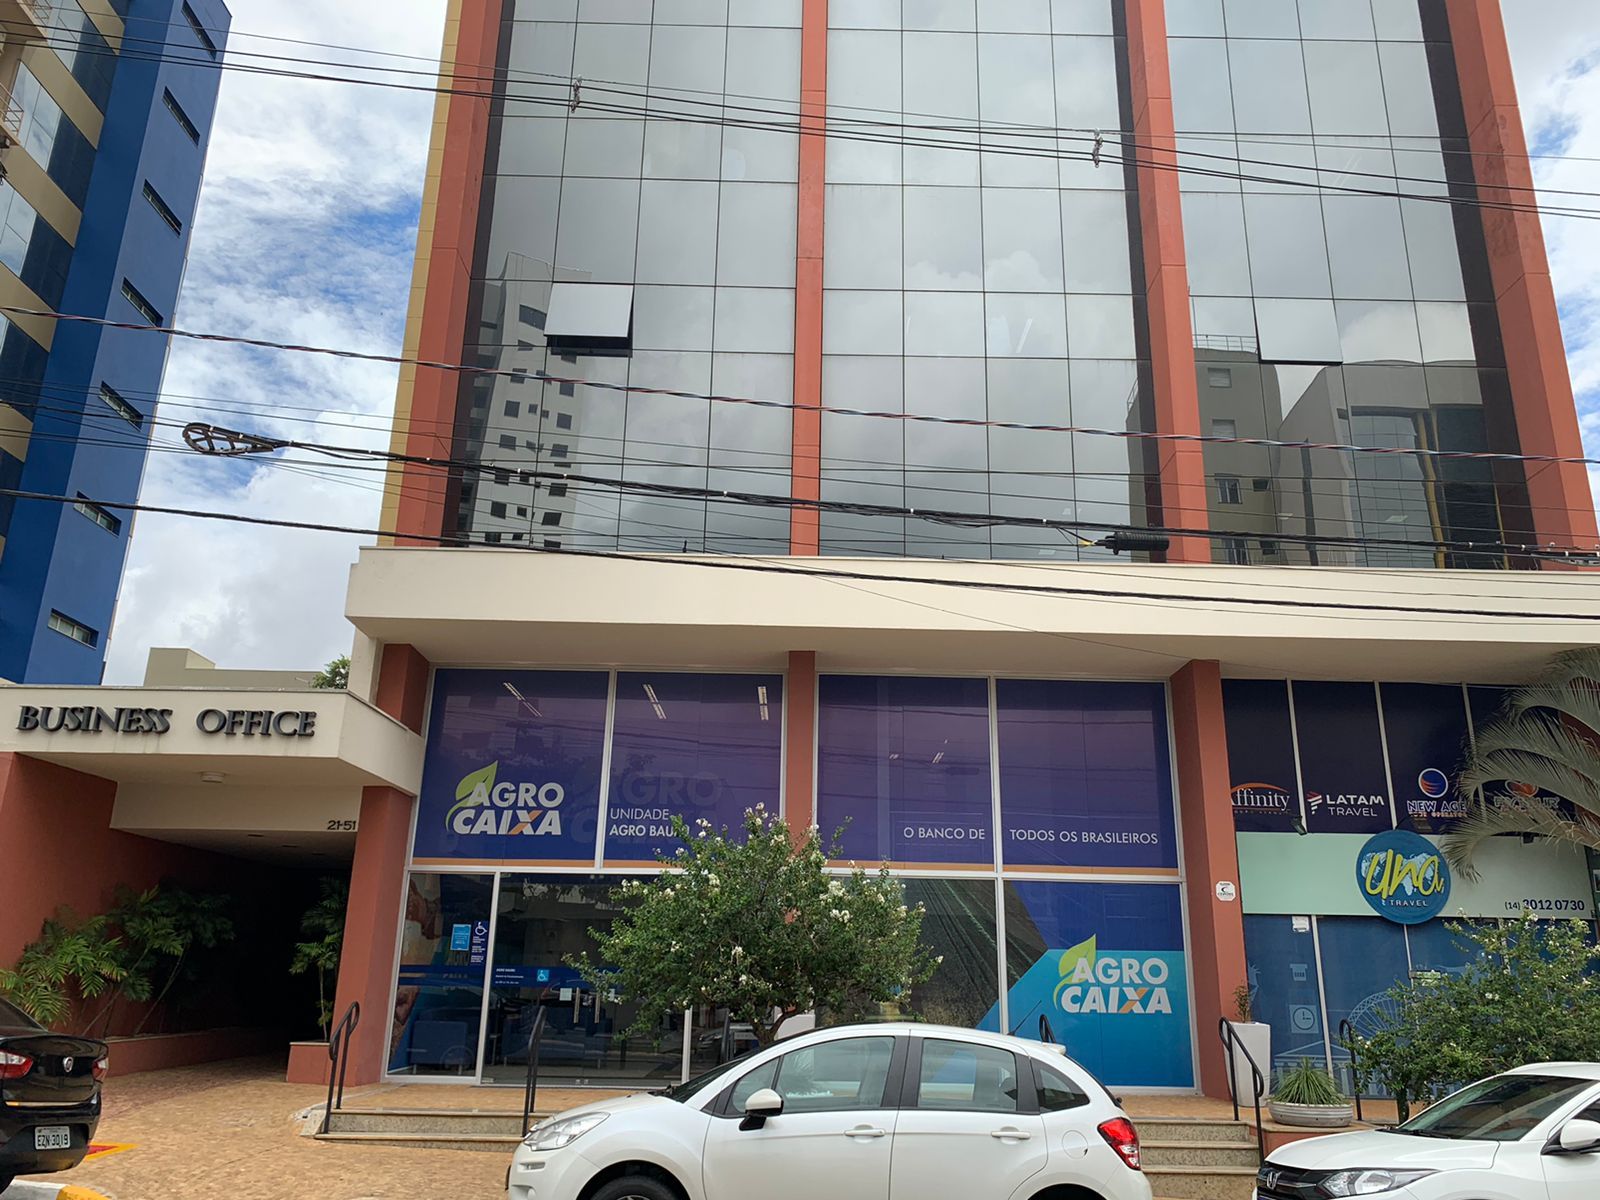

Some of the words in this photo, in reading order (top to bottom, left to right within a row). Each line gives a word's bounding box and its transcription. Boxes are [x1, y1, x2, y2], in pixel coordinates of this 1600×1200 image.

[16, 705, 173, 735] BUSINESS
[196, 709, 317, 737] OFFICE
[469, 782, 565, 807] AGRO
[1231, 788, 1290, 812] ffinity
[1326, 794, 1385, 806] LATAM
[1328, 806, 1378, 817] TRAVEL
[1407, 800, 1437, 812] NEW
[610, 808, 670, 820] UNIDADE
[327, 819, 357, 831] 21-51
[453, 810, 562, 836] CAIXA
[609, 825, 646, 836] AGRO
[649, 825, 690, 837] BAU
[903, 827, 914, 839] O
[918, 827, 965, 840] BANCO
[969, 828, 986, 840] DE
[1010, 829, 1055, 842] TODOS
[1059, 830, 1078, 843] OS
[1082, 831, 1158, 845] BRASILEIROS
[1390, 899, 1429, 907] TRAVEL
[1504, 901, 1521, 911] (14)
[1523, 899, 1553, 911] 3012
[1554, 899, 1585, 911] 0730
[1072, 957, 1169, 985] AGRO
[1061, 986, 1172, 1014] CAIXA
